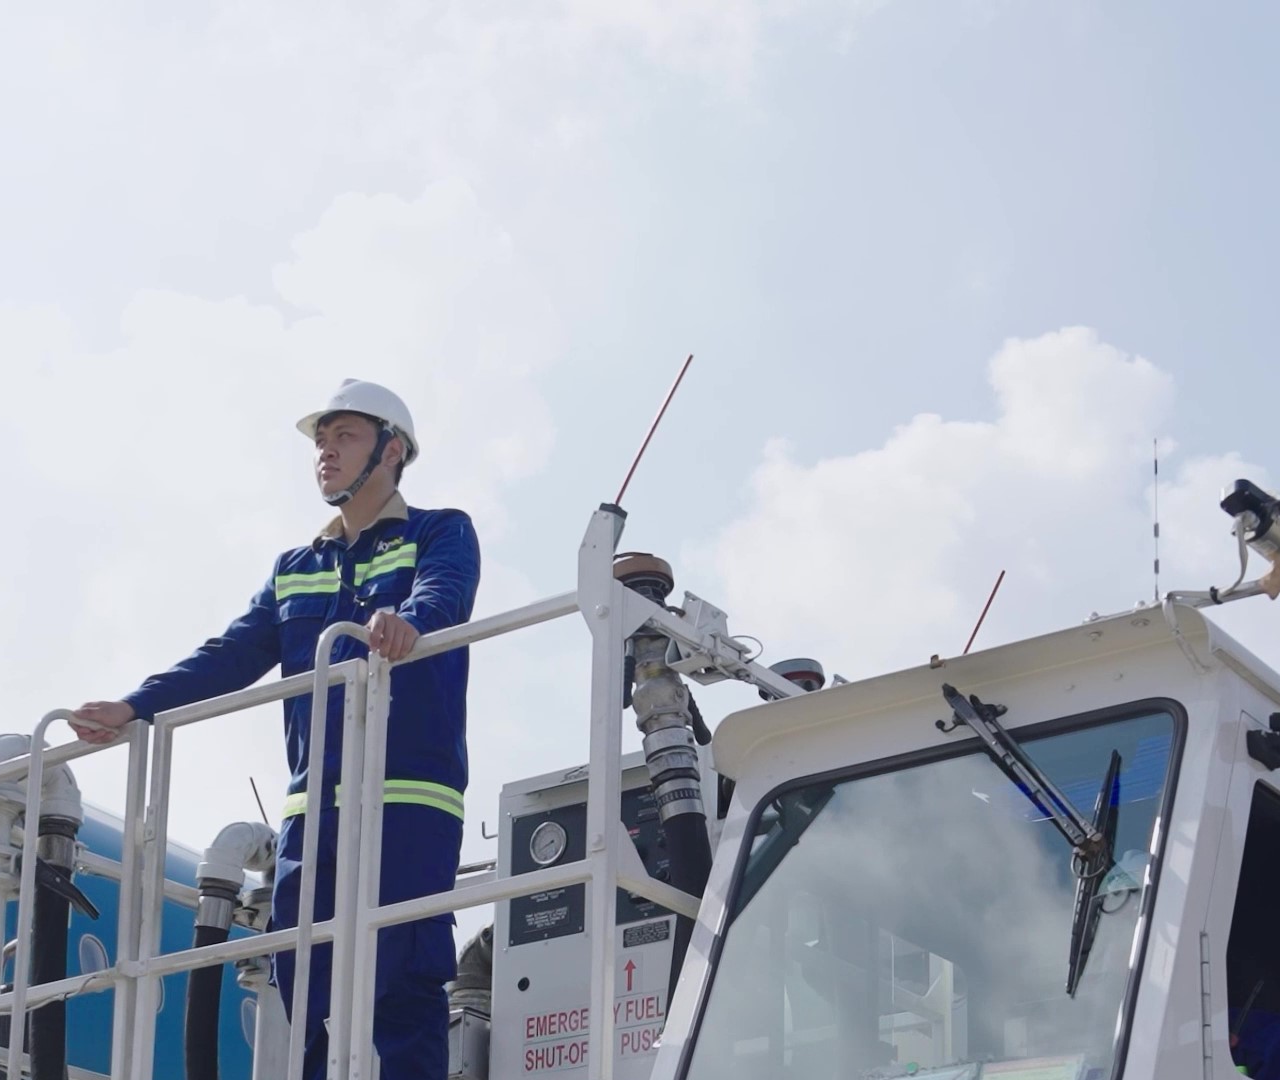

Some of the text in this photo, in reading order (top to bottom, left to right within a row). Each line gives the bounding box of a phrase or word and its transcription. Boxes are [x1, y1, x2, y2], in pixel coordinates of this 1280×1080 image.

[526, 996, 664, 1039] EMERGEY FUEL
[525, 1041, 589, 1071] SHUT-OF
